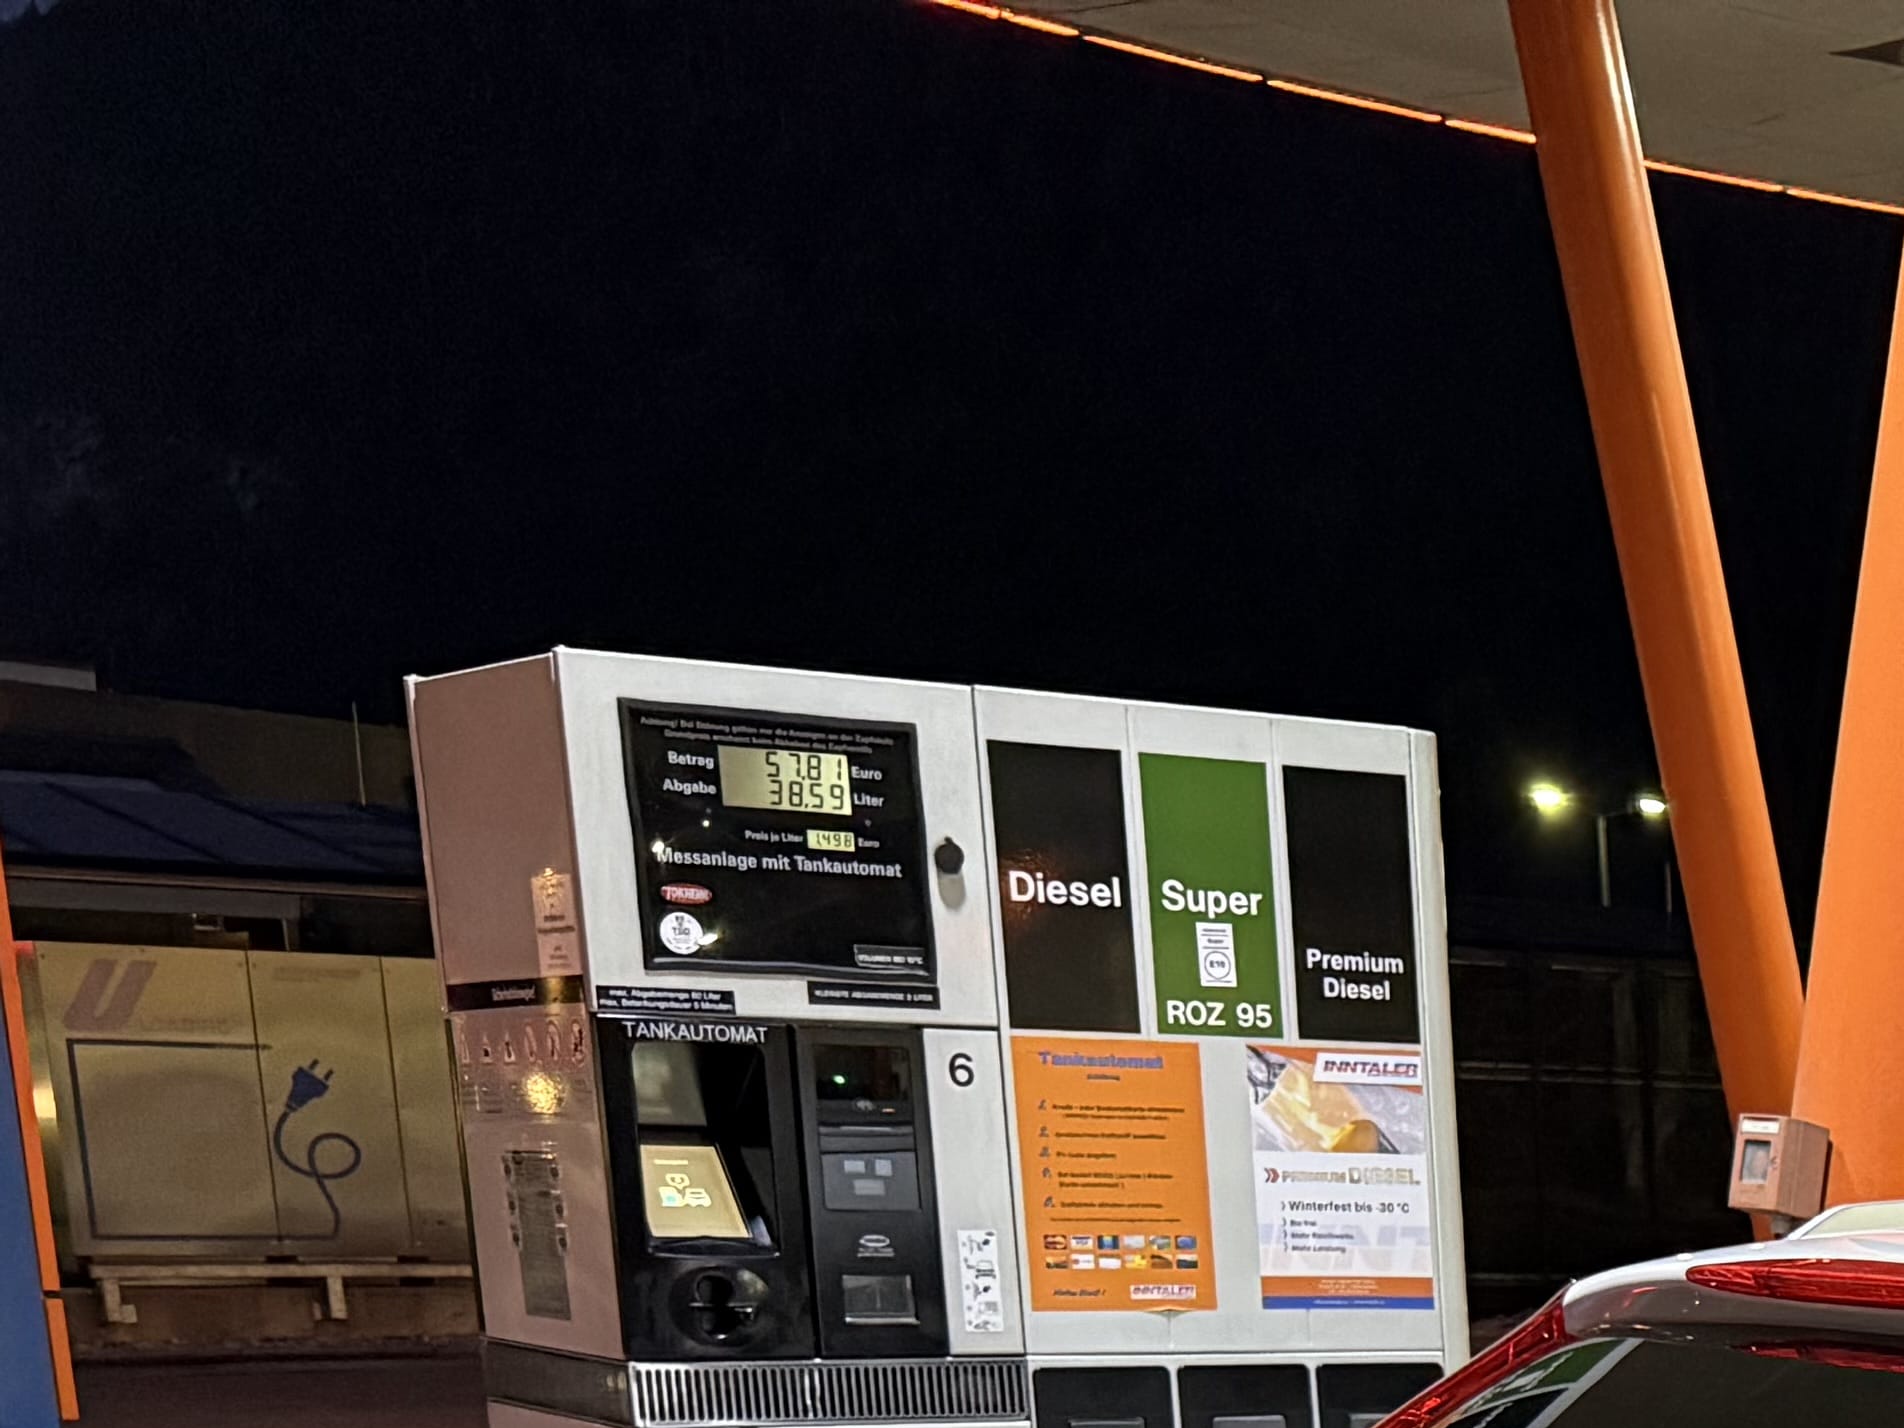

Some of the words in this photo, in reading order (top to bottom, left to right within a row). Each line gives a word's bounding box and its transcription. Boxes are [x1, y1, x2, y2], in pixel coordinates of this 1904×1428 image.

[668, 751, 714, 769] Betrag
[851, 767, 882, 781] Euro
[663, 778, 717, 795] Abgabe
[854, 793, 885, 808] Liter
[744, 830, 769, 841] Preis
[781, 832, 803, 842] Liter
[656, 847, 757, 869] Messanlage
[762, 856, 791, 871] mit
[794, 855, 903, 878] Tankautomat
[1008, 870, 1122, 907] Diesel
[1161, 879, 1264, 918] Super
[1306, 948, 1405, 974] Premium
[1322, 976, 1391, 1000] Diesel
[1166, 1000, 1227, 1026] ROZ
[1236, 1003, 1273, 1028] 95
[622, 1021, 768, 1043] TANKAUTOMAT
[948, 1053, 975, 1088] 6
[1323, 1060, 1419, 1076] INNTALER
[1288, 1200, 1352, 1212] Winterfest
[1354, 1201, 1373, 1213] bis
[1376, 1202, 1395, 1214] -30
